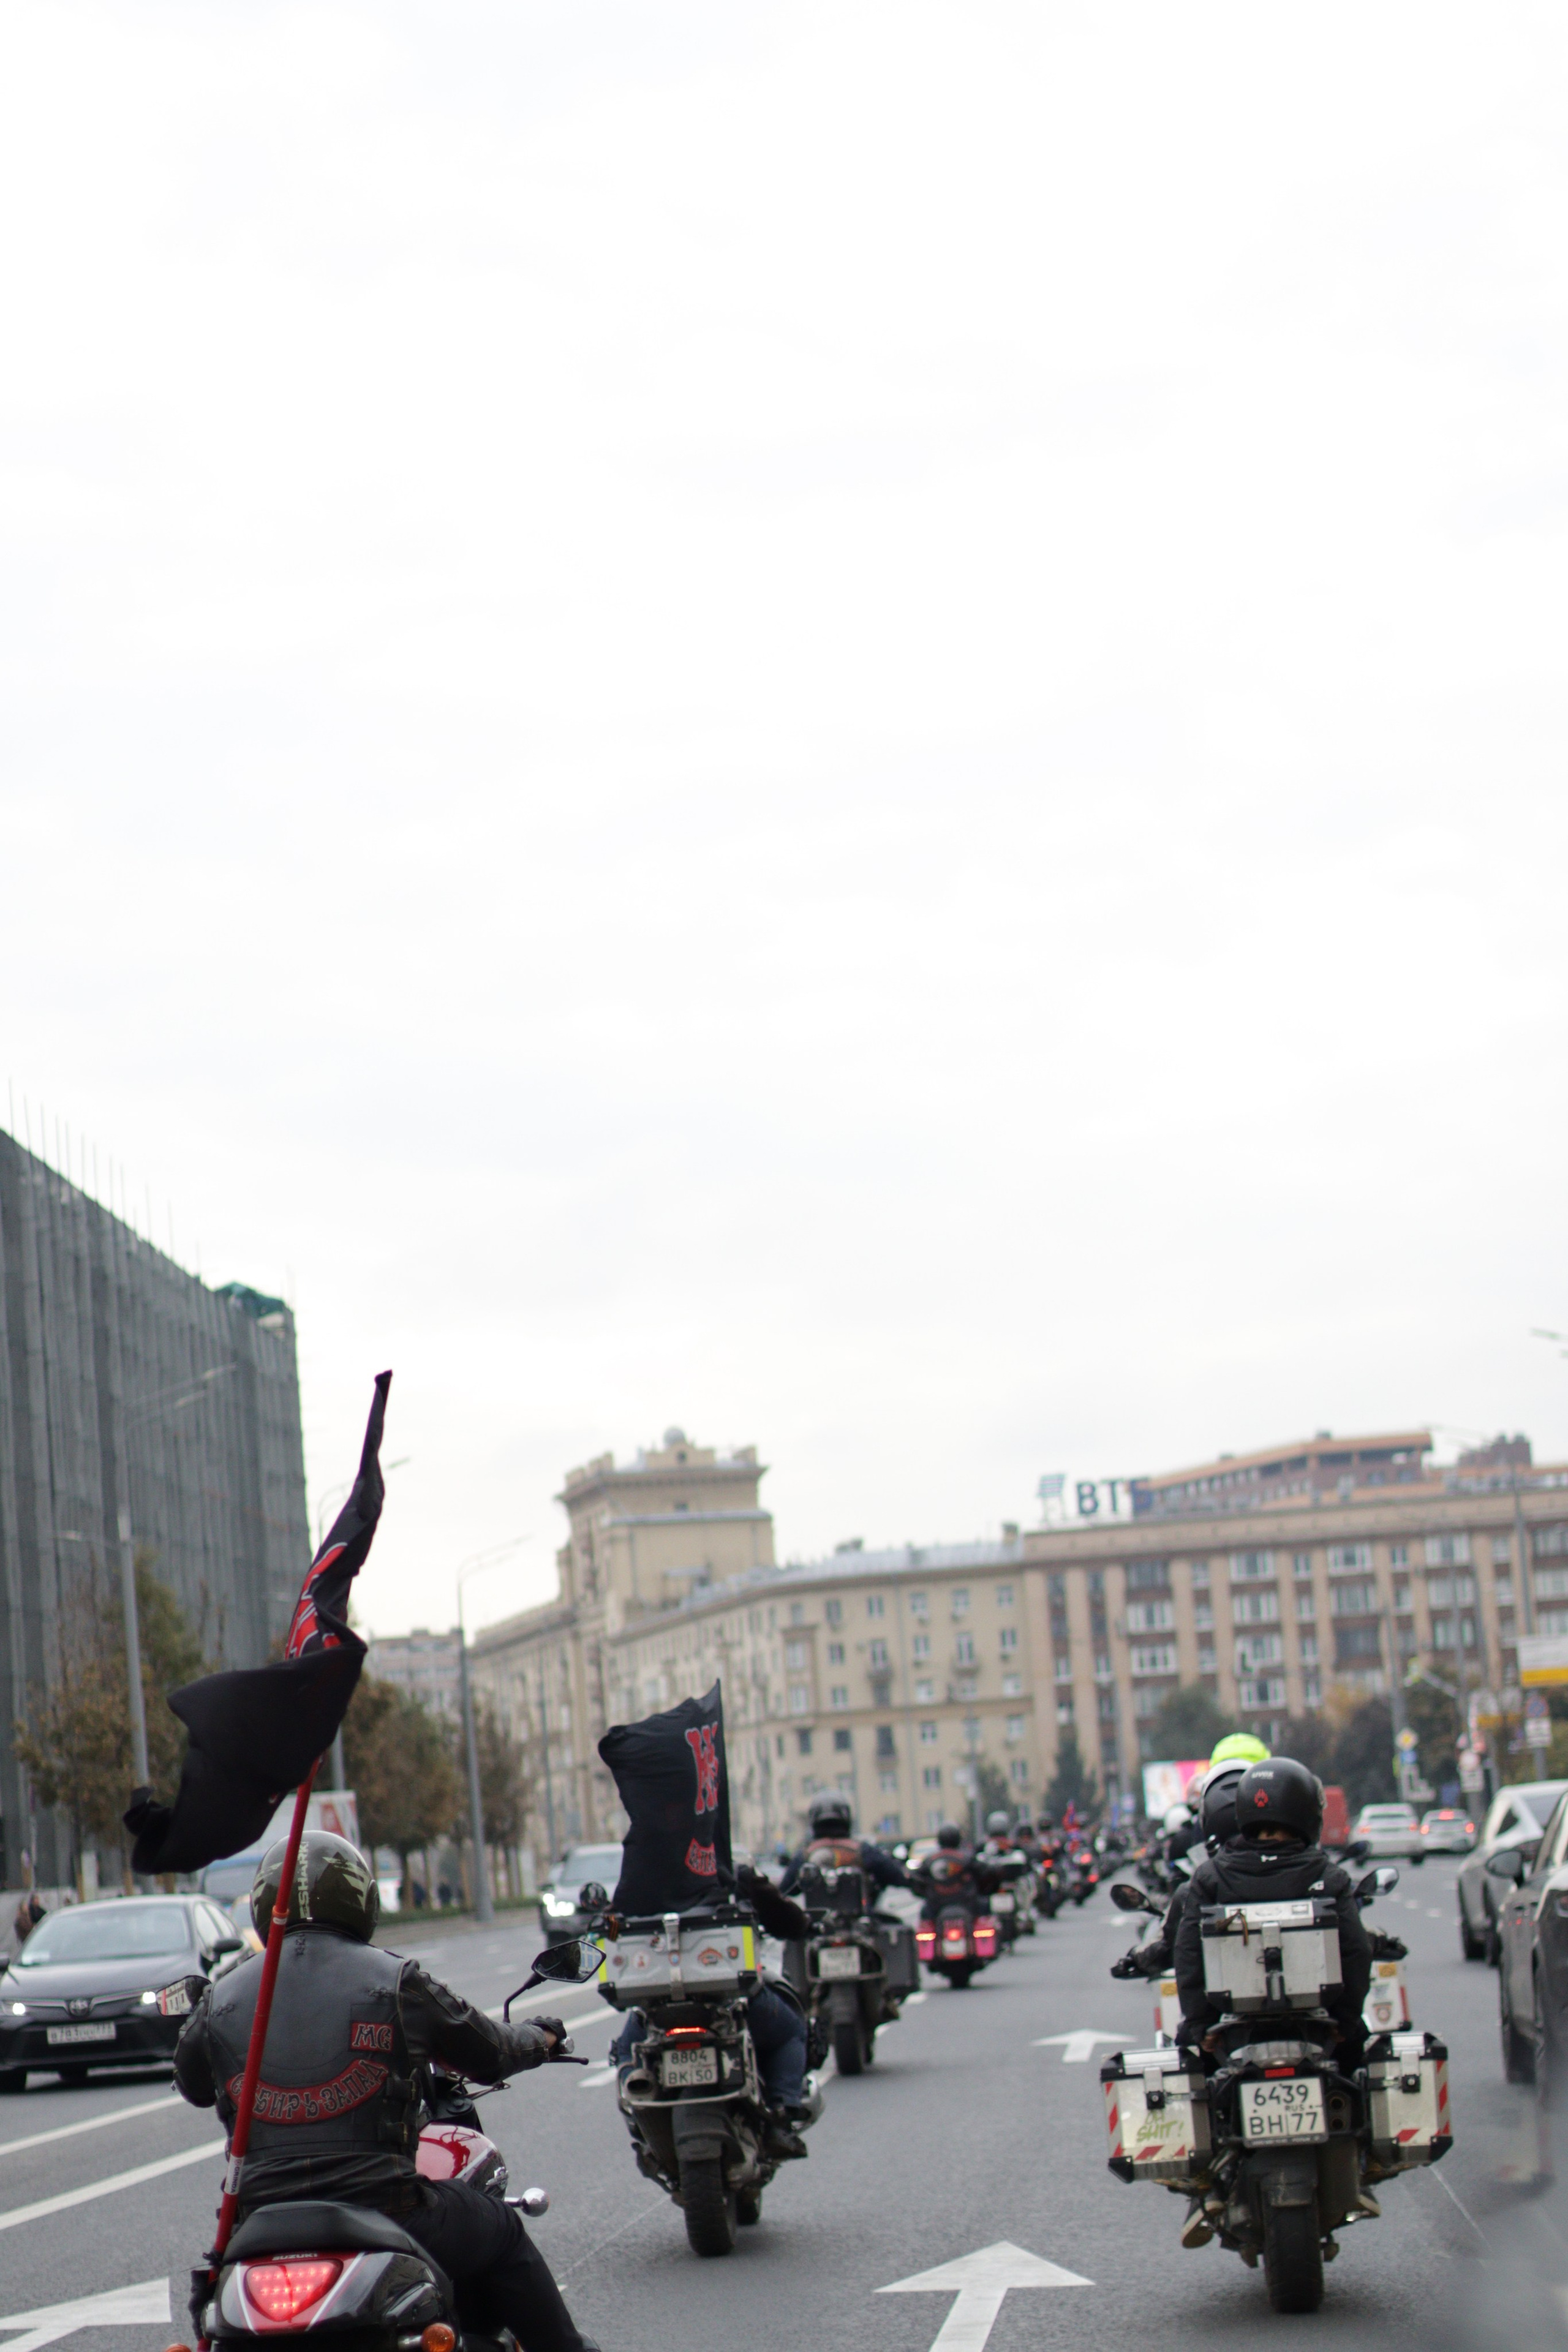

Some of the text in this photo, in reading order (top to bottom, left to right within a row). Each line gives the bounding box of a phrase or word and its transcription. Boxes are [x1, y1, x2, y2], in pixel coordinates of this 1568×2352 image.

[1076, 1477, 1154, 1517] ВТБ
[297, 1841, 310, 1906] SHARK
[671, 2049, 707, 2064] 8804
[230, 2059, 389, 2119] СБИРЬ-ЗАПАД
[1254, 2084, 1309, 2106] 6439
[1291, 2112, 1317, 2132] 77
